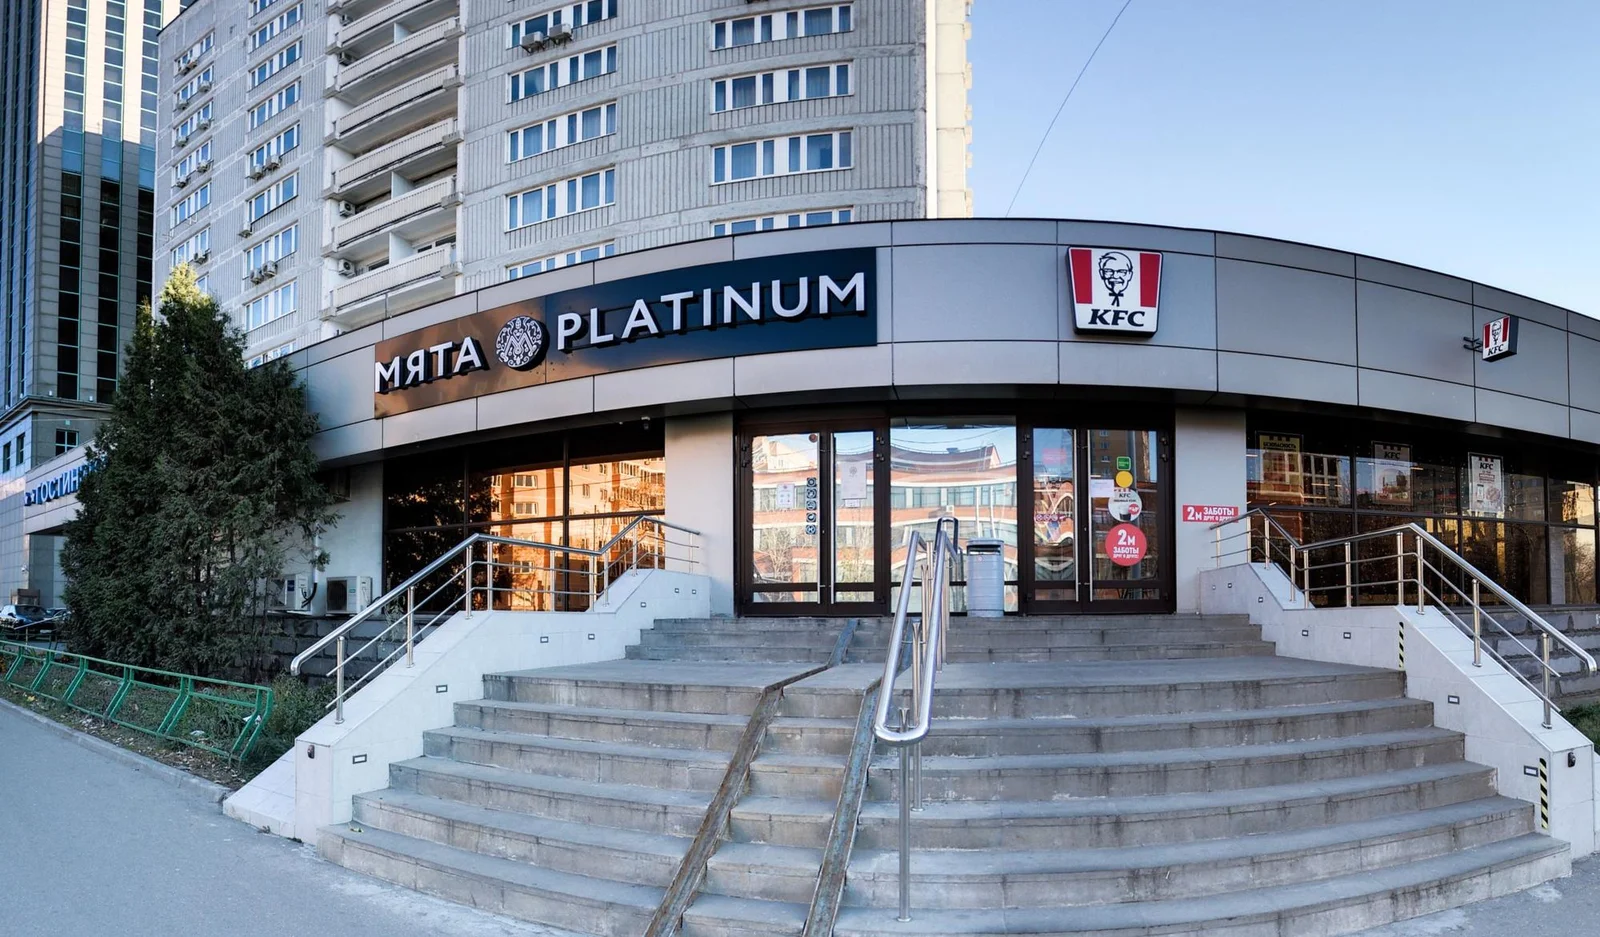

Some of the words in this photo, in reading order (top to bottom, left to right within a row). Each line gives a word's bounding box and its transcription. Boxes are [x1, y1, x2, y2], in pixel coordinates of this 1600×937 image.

[1088, 308, 1145, 327] KFC
[375, 336, 482, 393] МЯТА
[557, 272, 865, 351] PLATINUM
[1487, 343, 1504, 356] KFC
[1384, 451, 1401, 460] KFC
[1479, 462, 1494, 470] KFC
[34, 462, 89, 505] ГОСТИН
[1203, 506, 1235, 516] ЗАБОТЫ
[1113, 546, 1139, 554] ЗАБОТЫ
